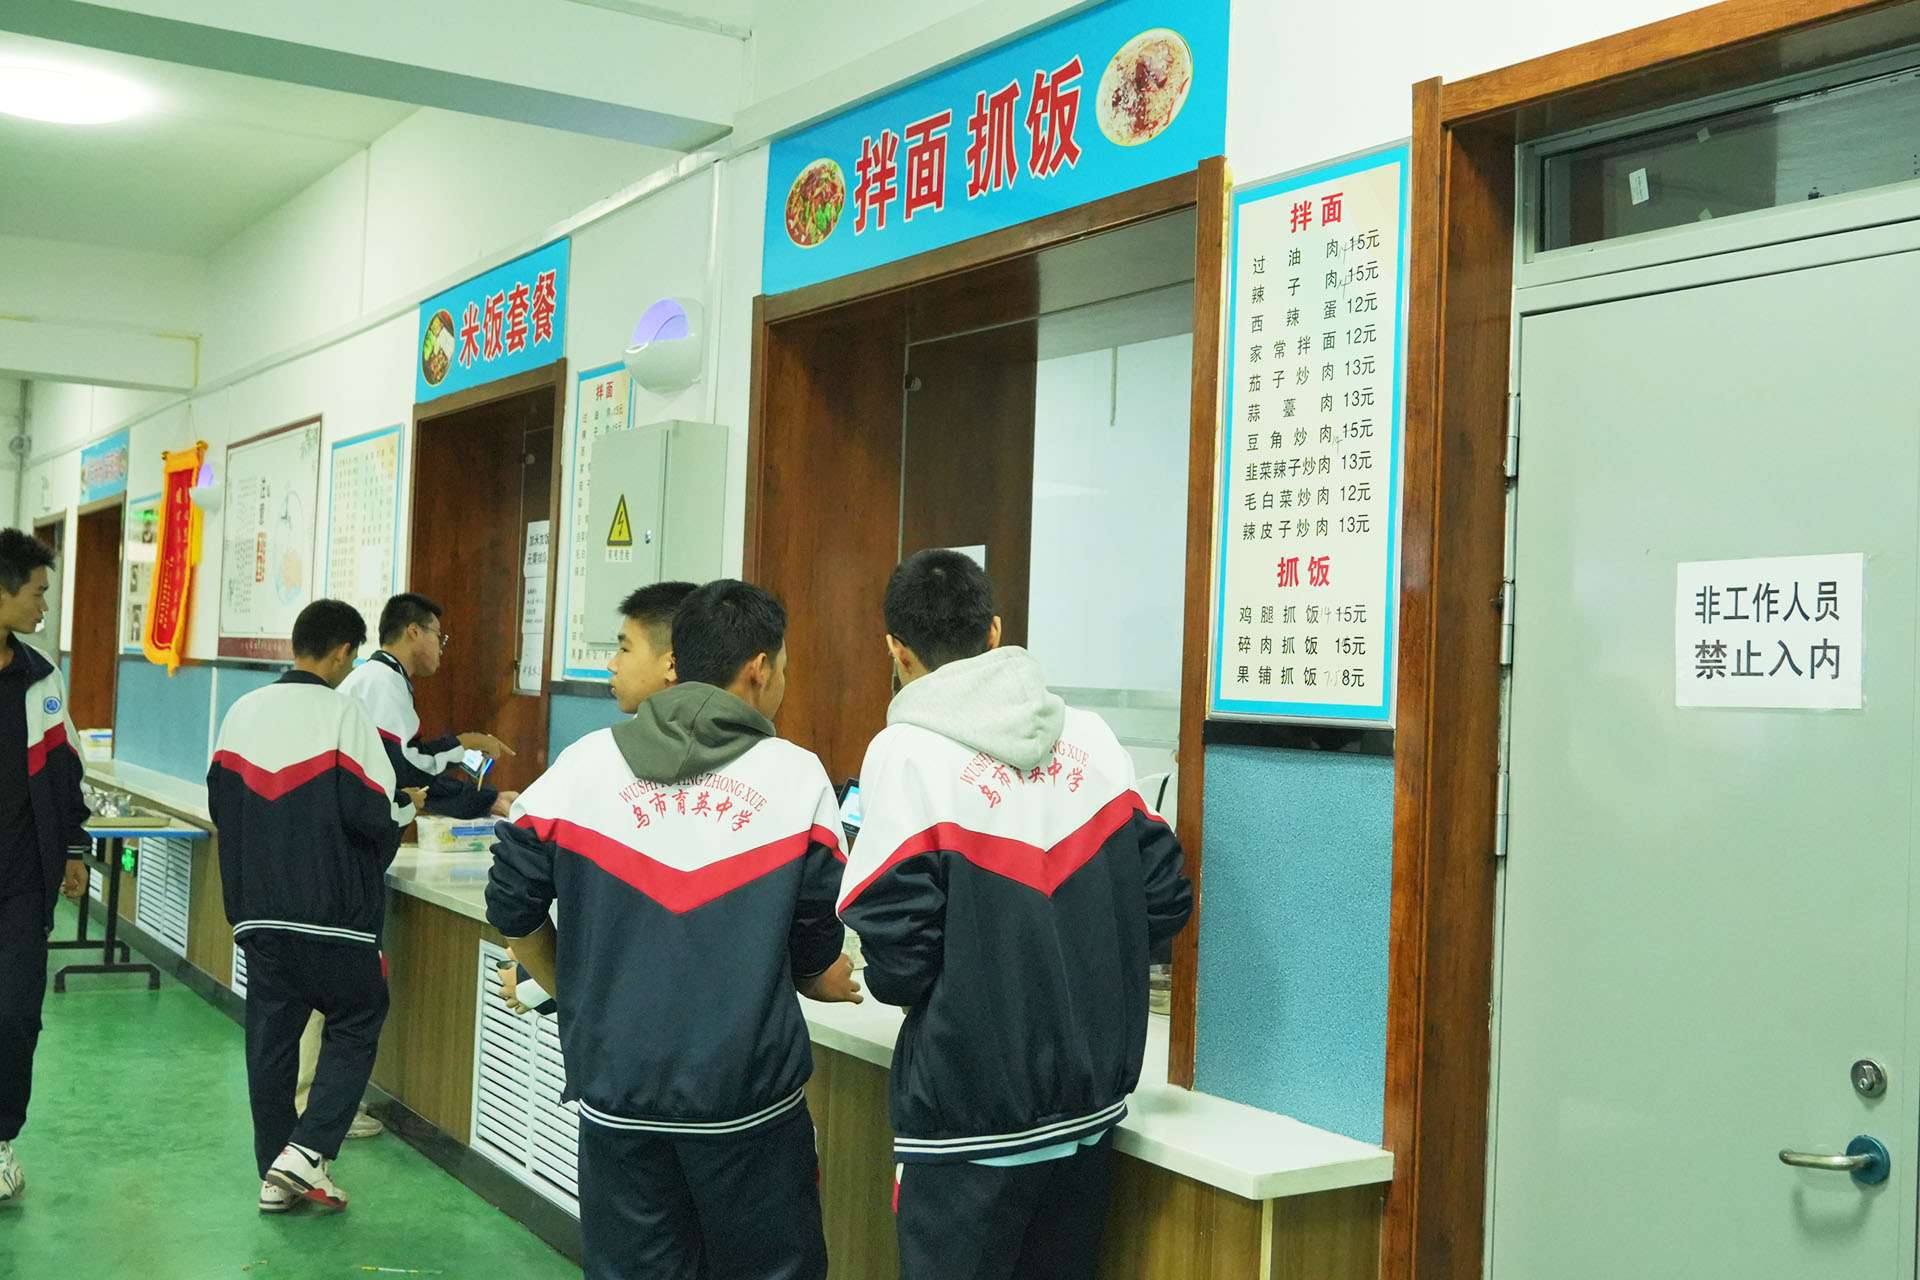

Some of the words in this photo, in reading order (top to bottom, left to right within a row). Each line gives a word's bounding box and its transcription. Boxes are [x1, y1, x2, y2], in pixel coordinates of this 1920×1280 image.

[854, 109, 952, 236] 拌面
[966, 56, 1083, 199] 抓饭
[1290, 192, 1344, 233] 拌面
[1252, 238, 1339, 275] 过油肉
[1349, 229, 1380, 251] 15元
[1251, 269, 1337, 304] 辣子肉
[1348, 260, 1379, 282] 15元
[460, 268, 556, 369] 米饭套餐
[1251, 300, 1336, 333] 西辣蛋
[1347, 292, 1378, 313] 12元
[1249, 331, 1336, 363] 家常拌面
[1346, 323, 1377, 345] 12元
[1248, 361, 1334, 393] 茄子炒肉
[1345, 355, 1376, 376] 13元
[1344, 387, 1375, 408] 13元
[1246, 424, 1332, 451] 豆角炒肉
[1342, 418, 1374, 439] 15元
[1245, 456, 1331, 482] 韭菜辣子炒肉
[1341, 450, 1373, 470] 13元
[1244, 486, 1330, 511] 毛白菜炒肉
[1340, 482, 1371, 502] 12元
[1242, 517, 1329, 541] 辣皮子炒肉
[1339, 513, 1370, 534] 13元
[1277, 555, 1331, 588] 抓饭
[1239, 605, 1319, 625] 鸡腿抓饭
[1336, 604, 1367, 624] 15元
[1695, 581, 1840, 624] 非工作人员
[1238, 635, 1318, 655] 碎肉抓饭
[1335, 636, 1366, 656] 15元
[1695, 638, 1840, 680] 禁止入内
[1237, 665, 1317, 687] 果铺抓饭
[1342, 668, 1365, 687] 8元
[632, 788, 754, 832] 乌市育英中学
